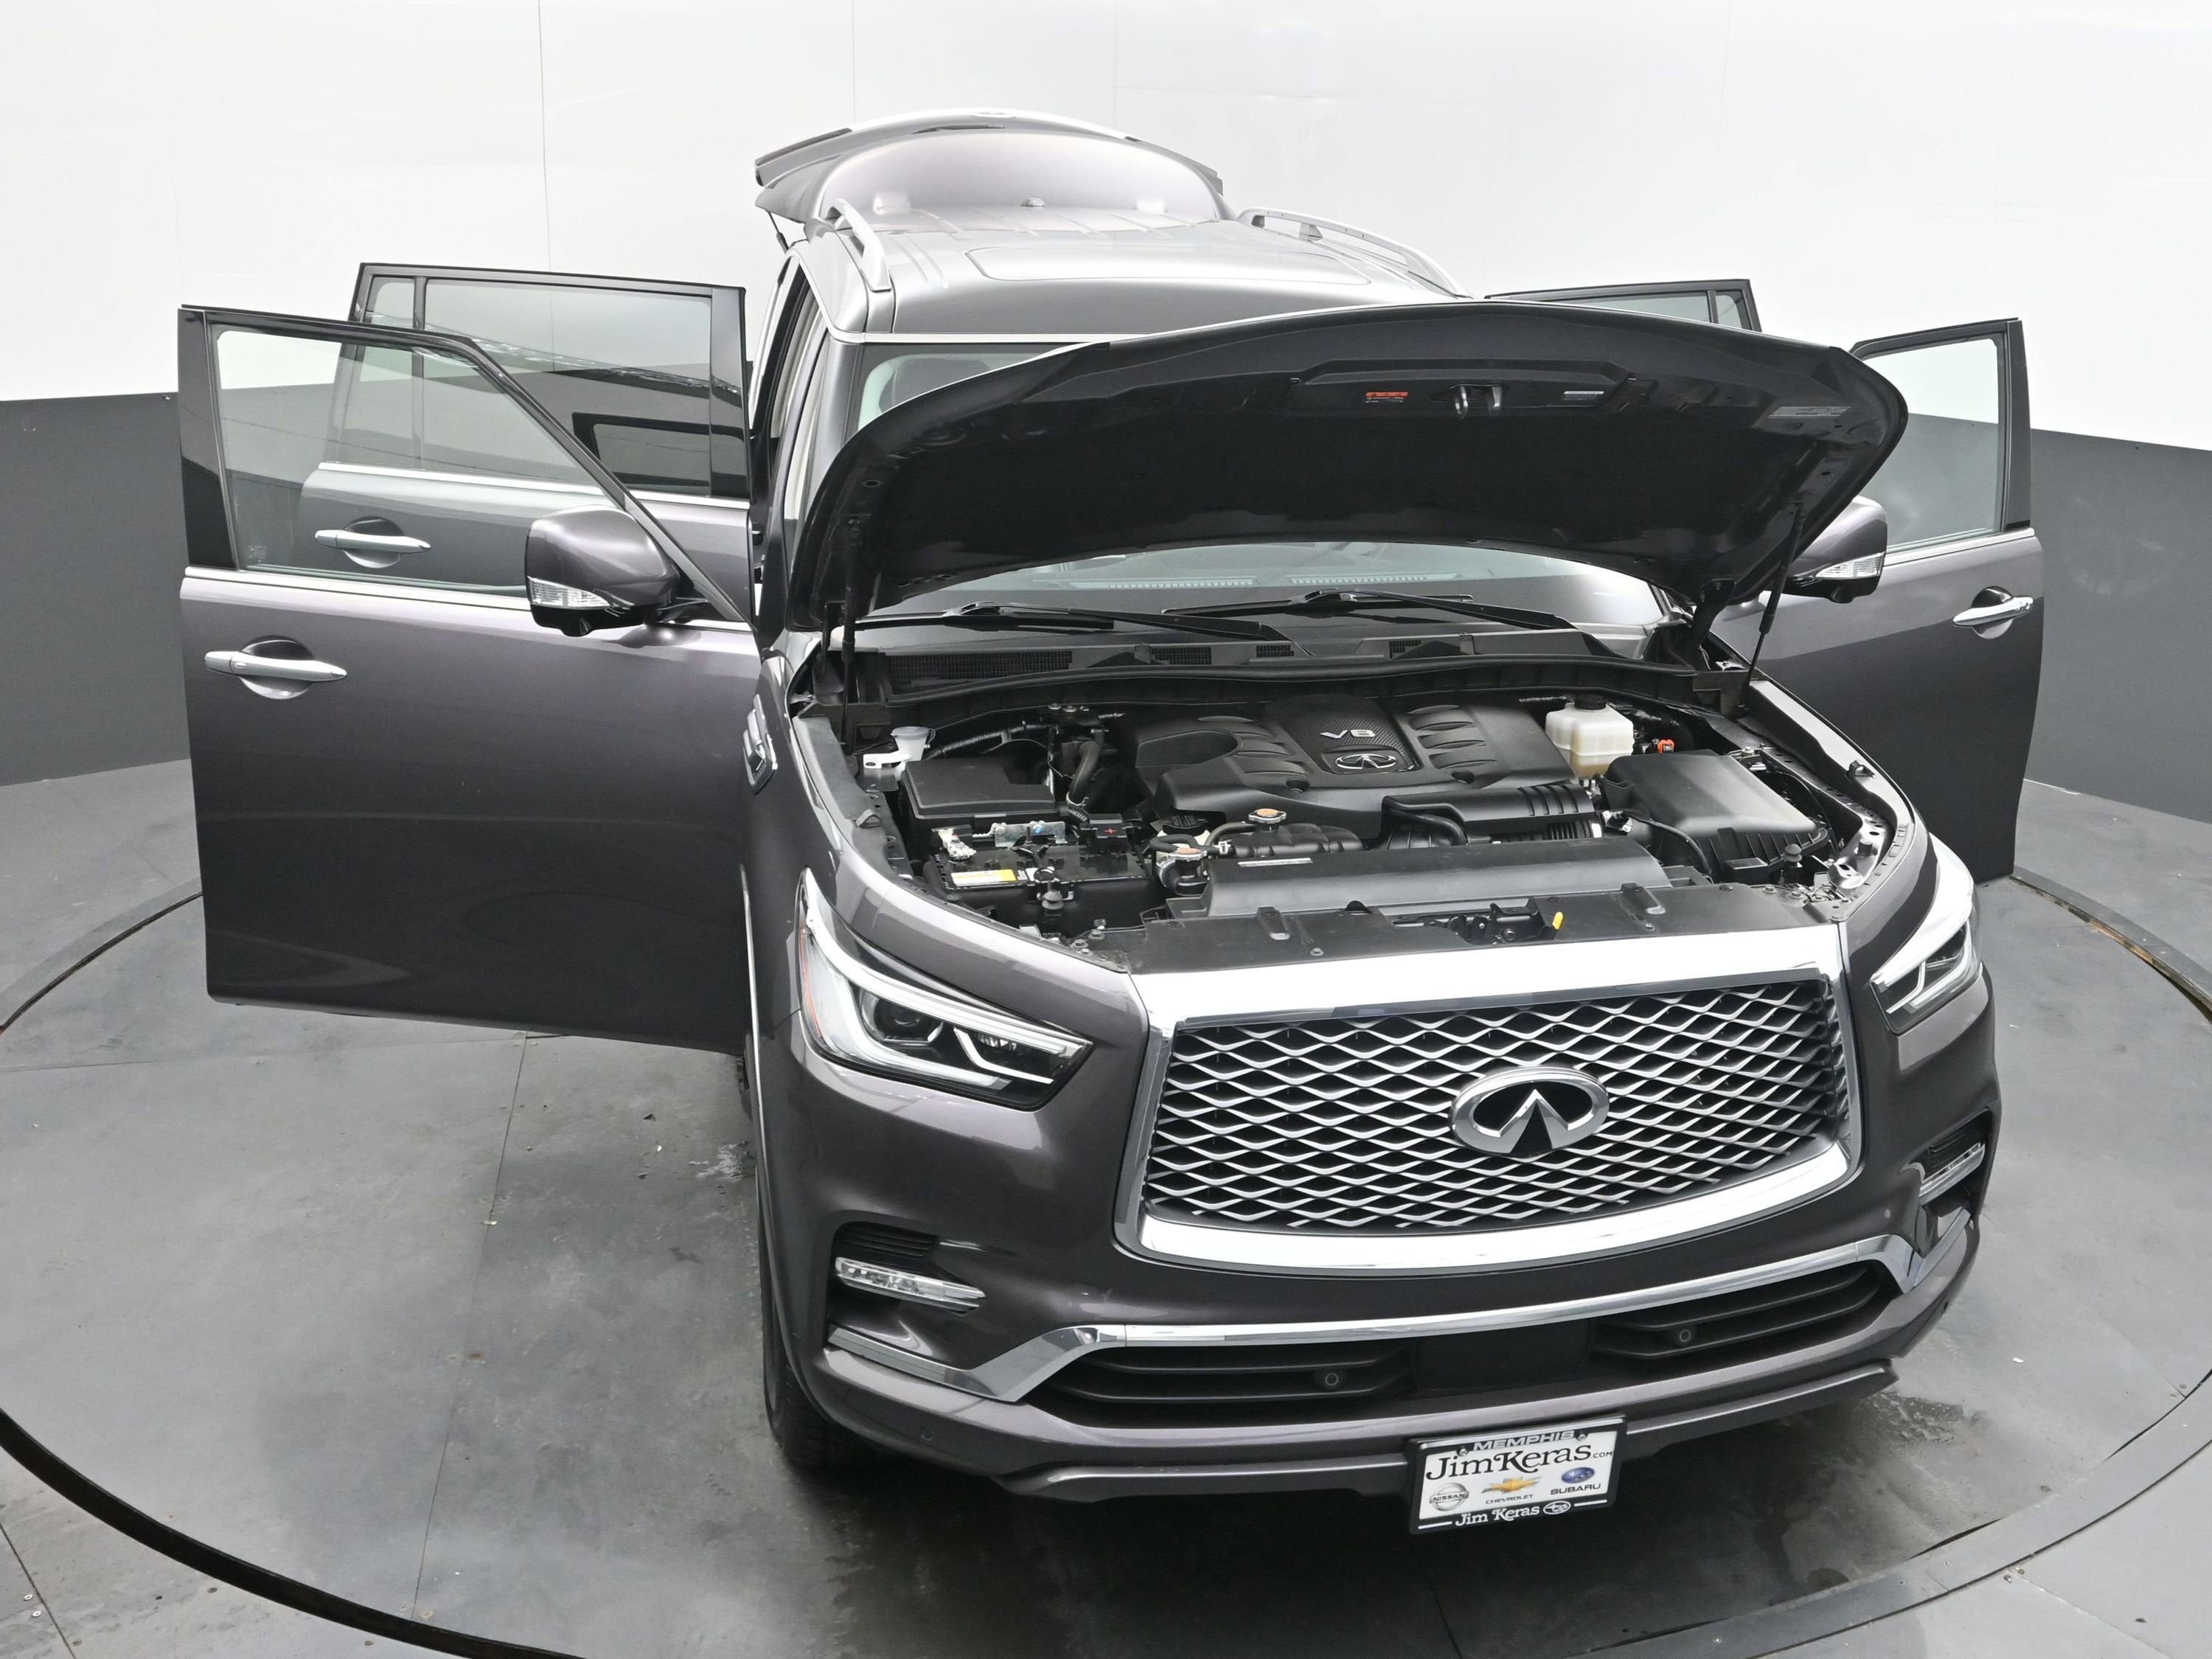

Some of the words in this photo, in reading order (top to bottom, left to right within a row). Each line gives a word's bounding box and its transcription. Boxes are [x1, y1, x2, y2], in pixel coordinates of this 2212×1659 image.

[1473, 1430, 1575, 1451] MEMPHIS
[1550, 1483, 1601, 1495] SUBARU
[1433, 1493, 1466, 1502] NISSAN
[1485, 1494, 1534, 1505] CHEVROLET
[1455, 1512, 1489, 1526] Jim
[1491, 1506, 1540, 1522] Keras
